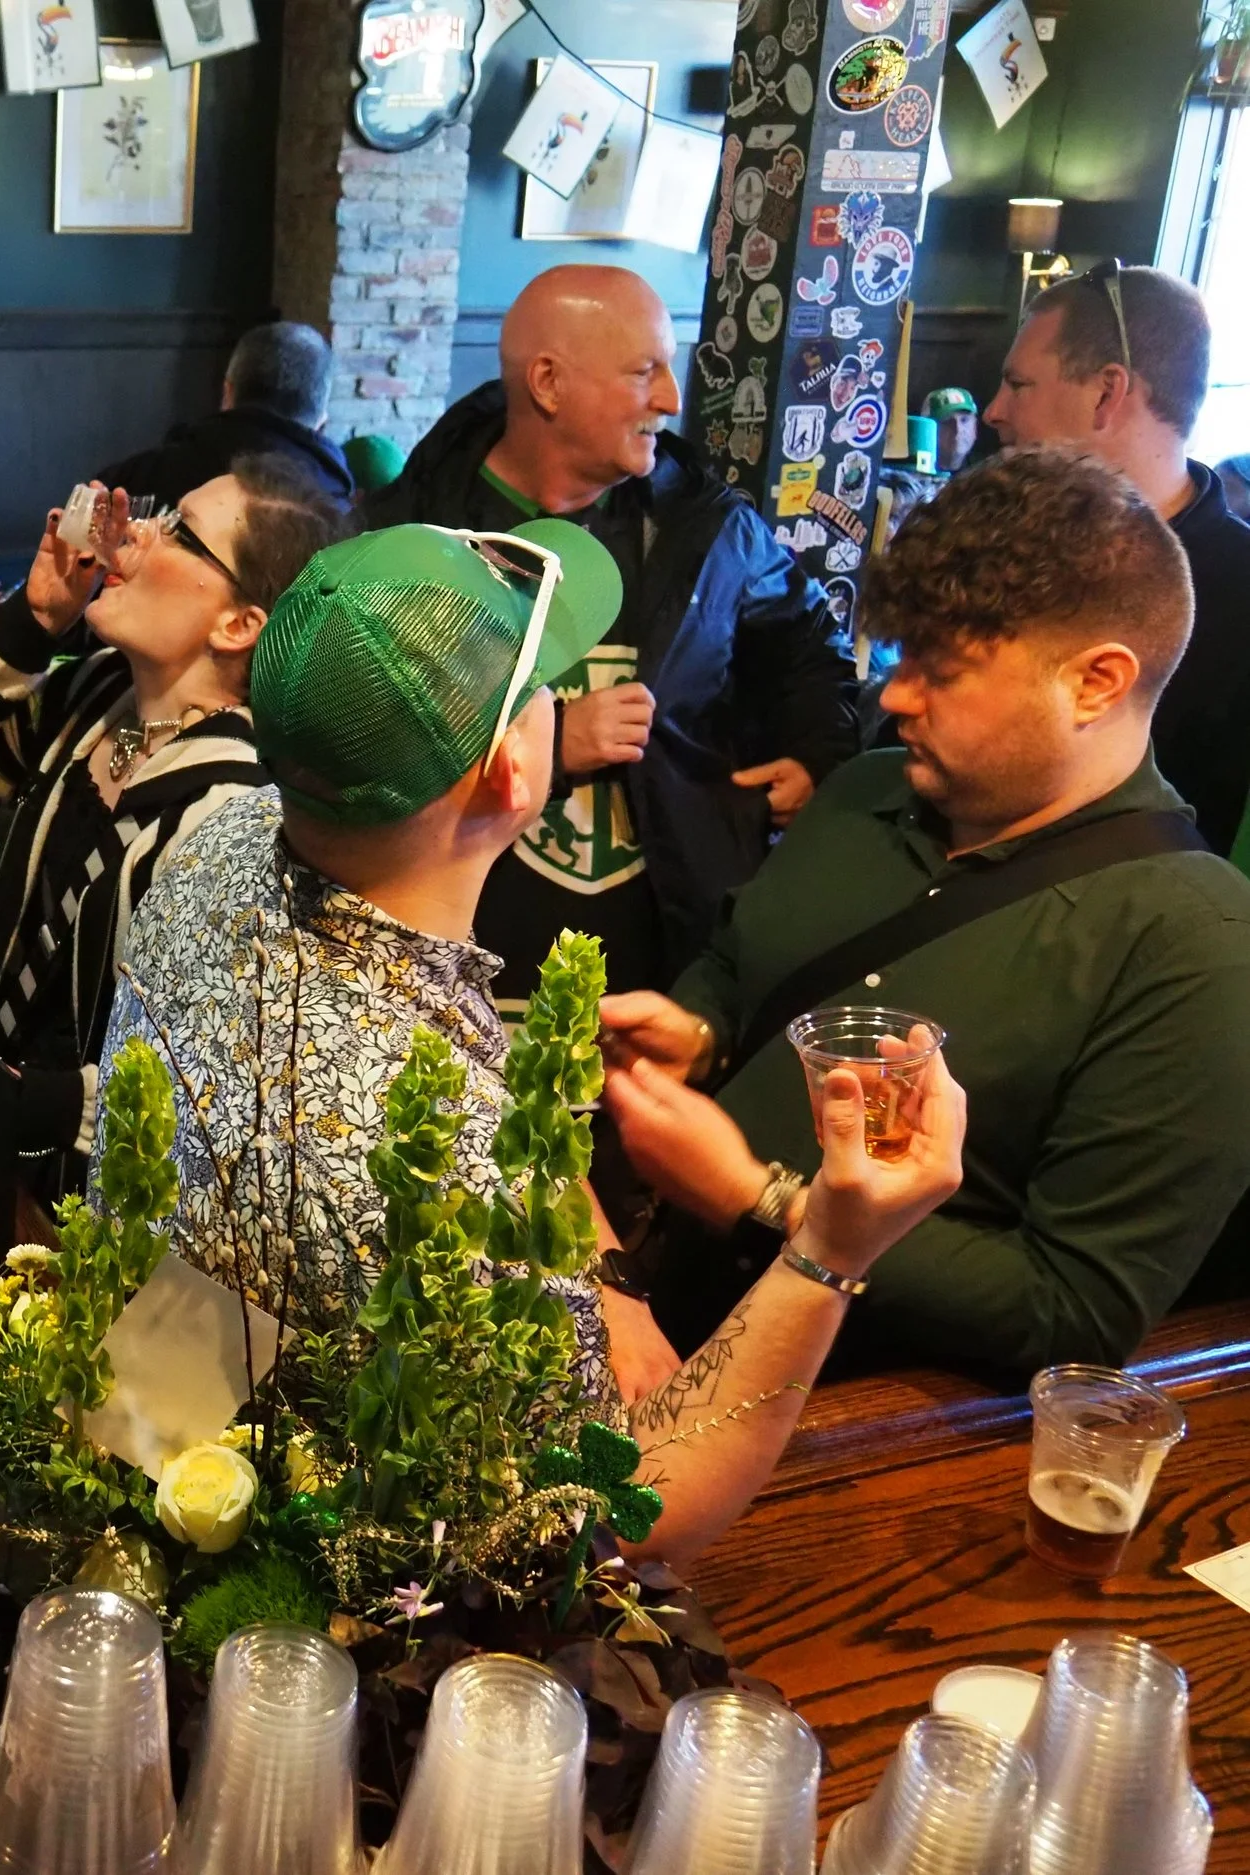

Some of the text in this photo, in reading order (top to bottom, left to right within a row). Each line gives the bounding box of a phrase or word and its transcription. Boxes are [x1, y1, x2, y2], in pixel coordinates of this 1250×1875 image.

[837, 41, 874, 70] MAMMOTH
[891, 126, 925, 143] HEART
[860, 231, 883, 257] LOVE
